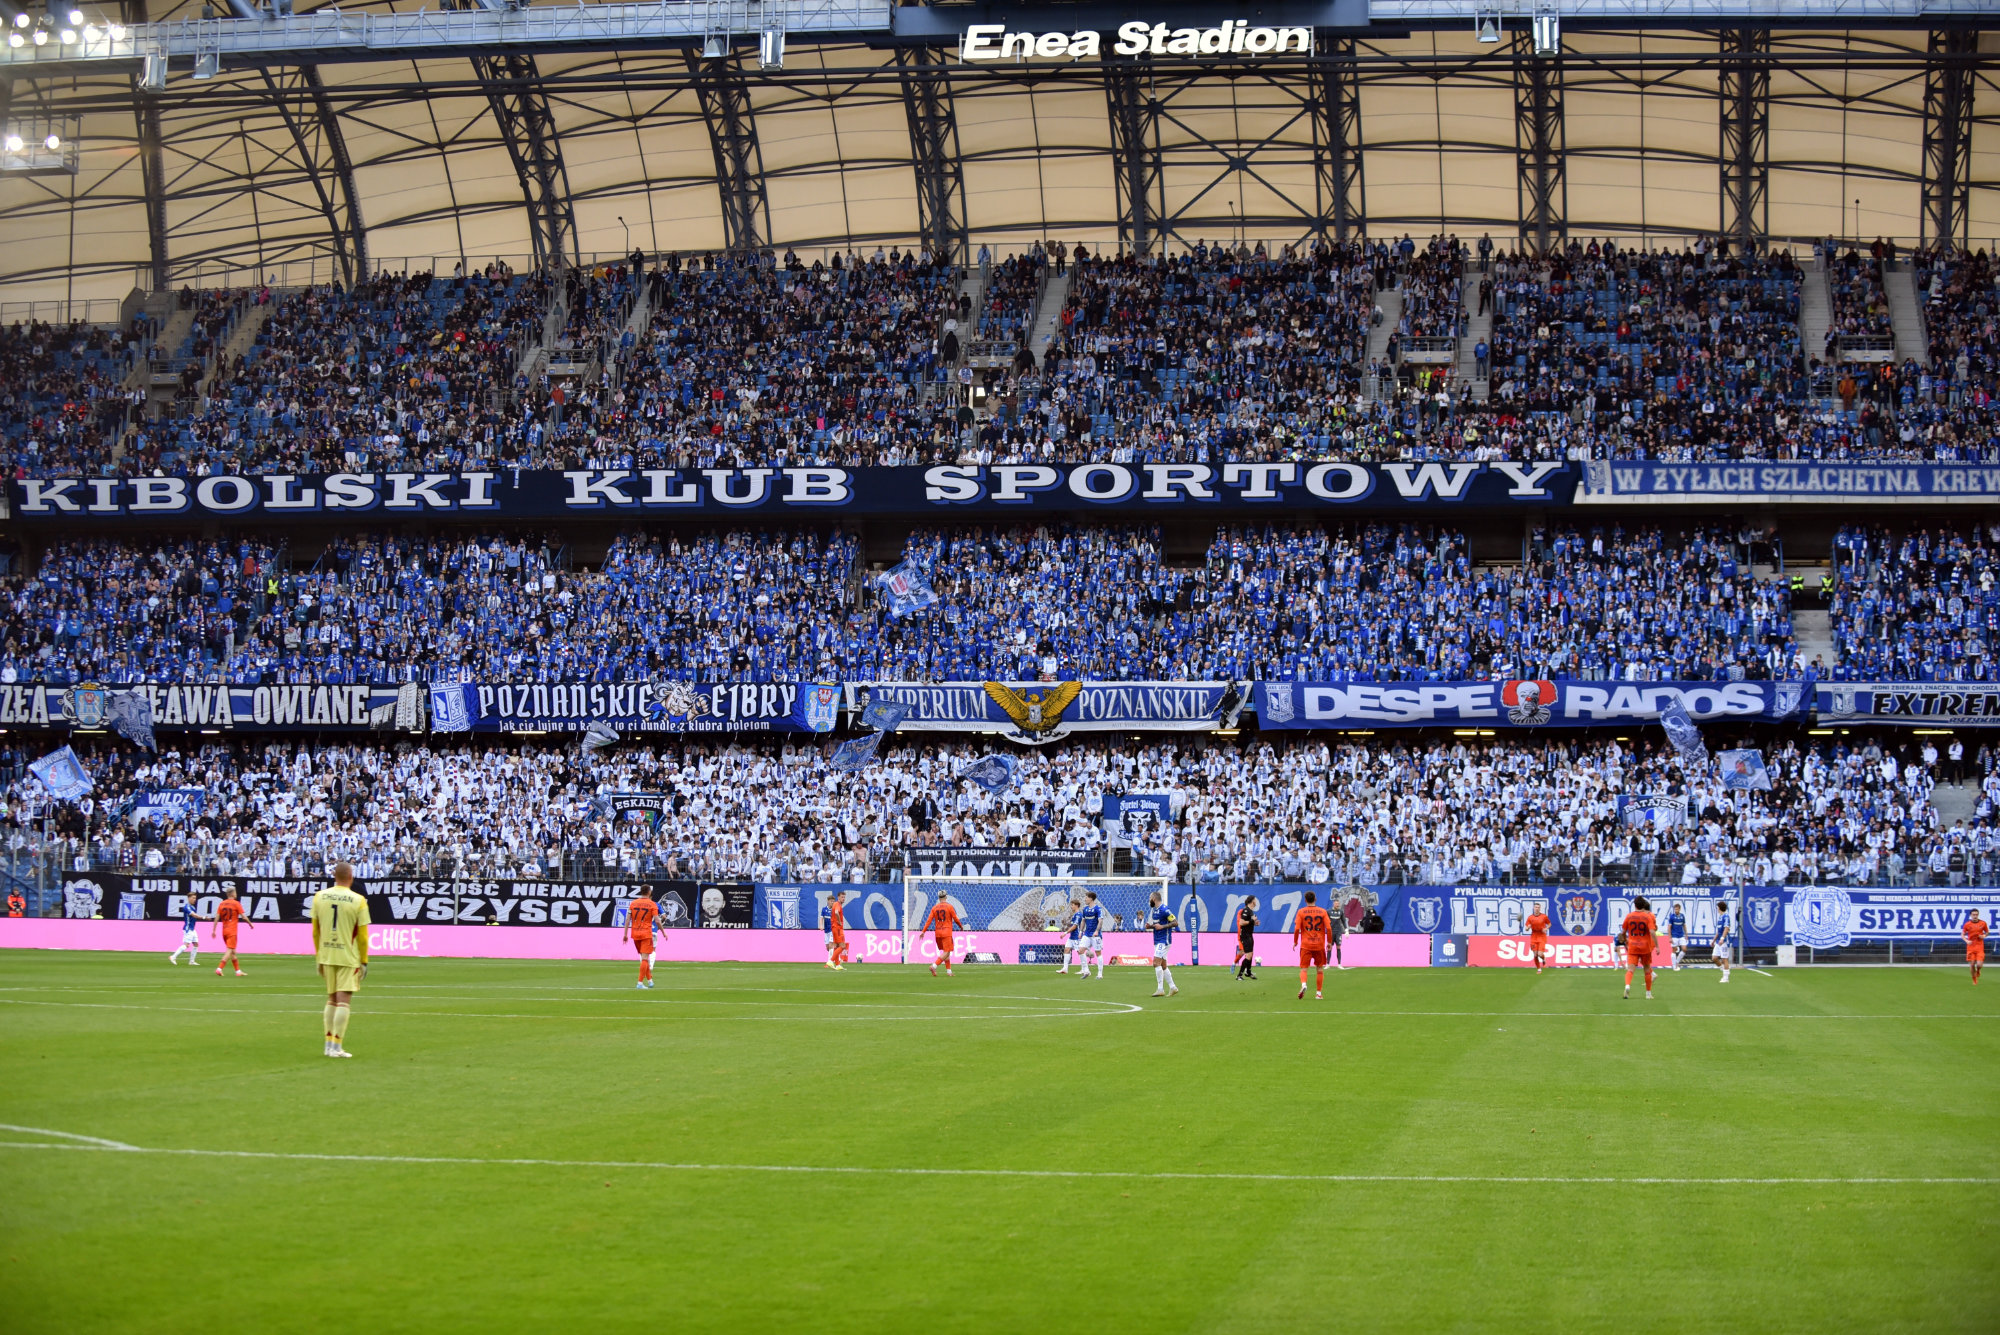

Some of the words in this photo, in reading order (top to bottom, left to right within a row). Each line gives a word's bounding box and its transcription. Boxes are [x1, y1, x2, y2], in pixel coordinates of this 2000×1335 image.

[962, 24, 1099, 60] Enea
[1114, 19, 1313, 56] Stadion
[17, 472, 498, 513] KIBOLSKI
[564, 468, 852, 506] KLUB
[924, 461, 1566, 503] SPORTOWY
[1613, 468, 1643, 491] W
[1760, 467, 1921, 492] SZLACHETNA
[253, 685, 370, 725] OWIANE
[1078, 686, 1211, 719] POZNAŃSKIE
[1304, 684, 1498, 722] DESPE
[1564, 682, 1764, 720] RADOS
[567, 722, 577, 731] w
[688, 719, 723, 731] klubra
[726, 719, 770, 733] poletom
[916, 849, 947, 857] SERCE
[950, 849, 1000, 857] STADIONU
[1009, 849, 1037, 857] DUMA
[1041, 850, 1087, 859] POKOLEŃ
[131, 878, 179, 893] LUBI
[190, 879, 236, 895] NAS
[364, 879, 500, 898] WIĘKSZOŚĆ
[769, 890, 781, 898] KKS
[783, 890, 798, 898] LECH
[1454, 887, 1501, 897] PYRLANDIA
[1504, 887, 1543, 897] FOREVER
[1622, 887, 1670, 897] PYRLANDIA
[1671, 887, 1711, 897] FOREVER
[322, 893, 354, 904] CHOVAN
[331, 904, 338, 931] 1
[388, 895, 611, 925] WSZYSCY
[633, 907, 650, 922] 77
[936, 909, 947, 922] 13
[1450, 897, 1550, 937] LECH
[1304, 915, 1323, 931] 32
[1629, 921, 1647, 937] 29
